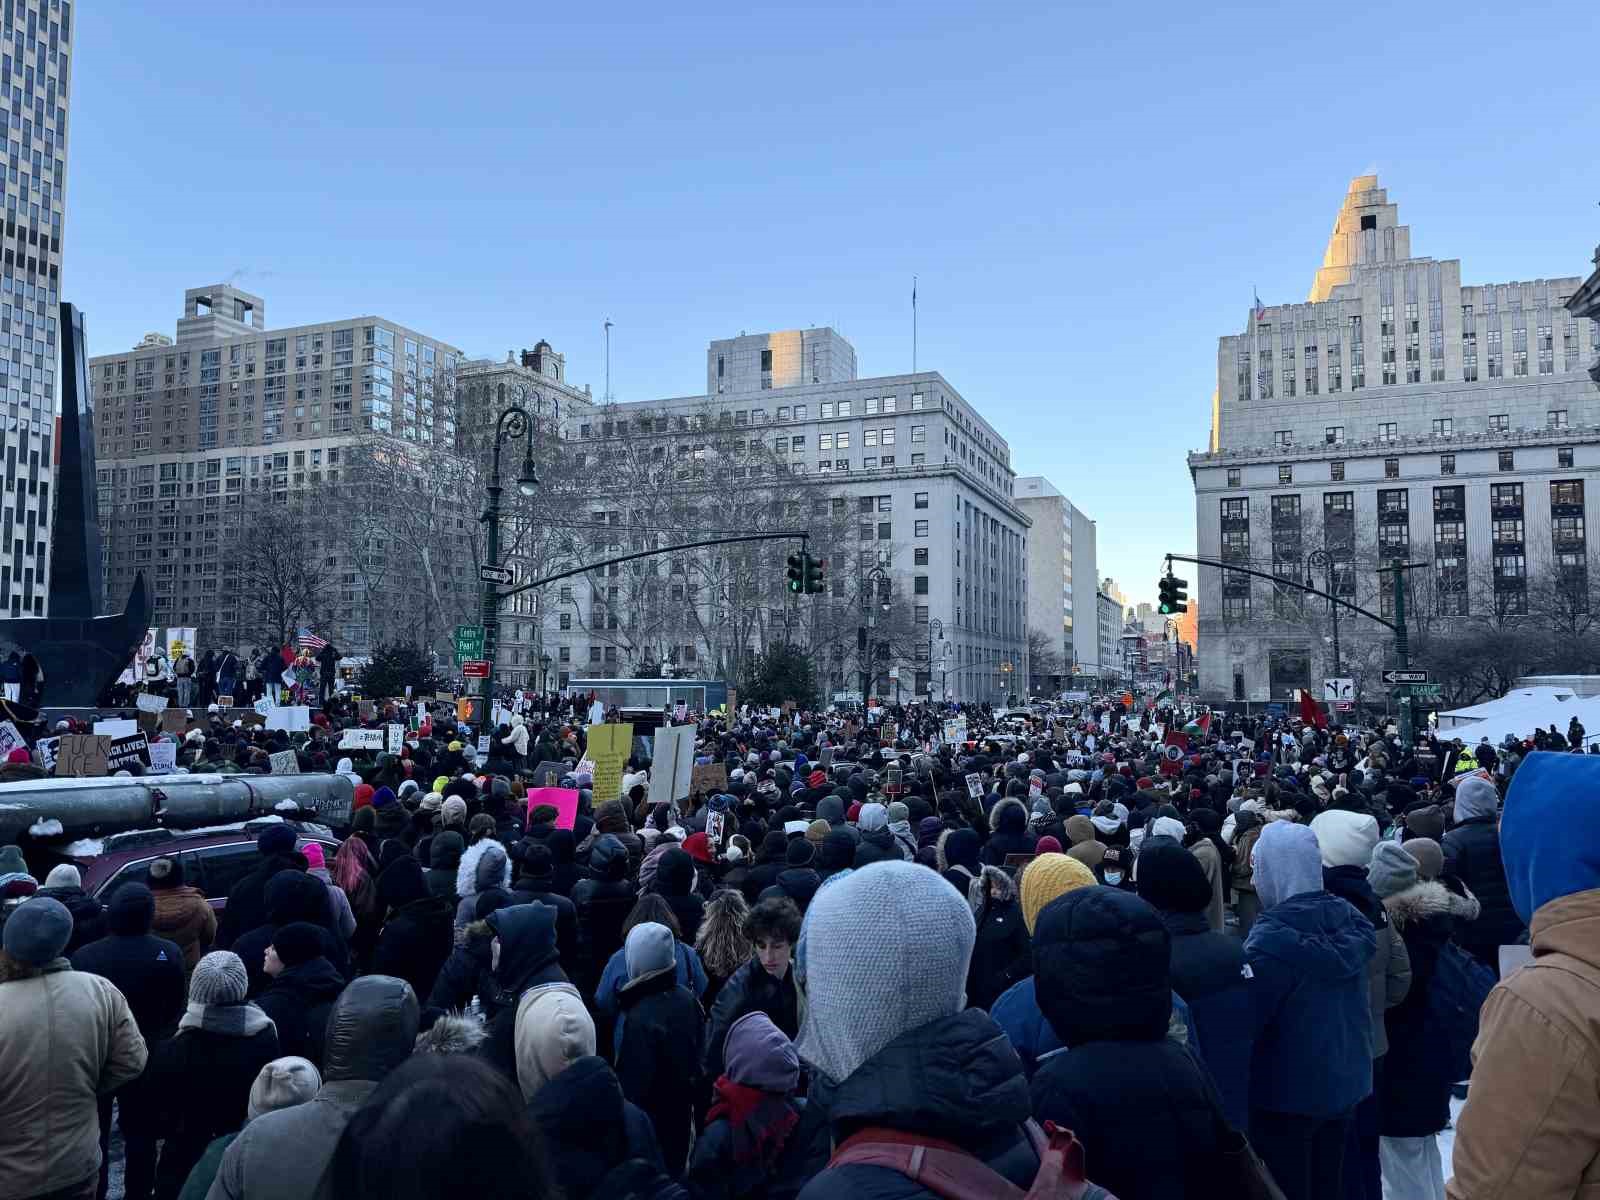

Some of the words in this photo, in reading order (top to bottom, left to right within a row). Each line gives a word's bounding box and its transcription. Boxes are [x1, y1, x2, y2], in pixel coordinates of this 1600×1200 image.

[60, 735, 111, 757] FUCK
[123, 740, 146, 753] LIVES
[68, 754, 97, 773] ICE
